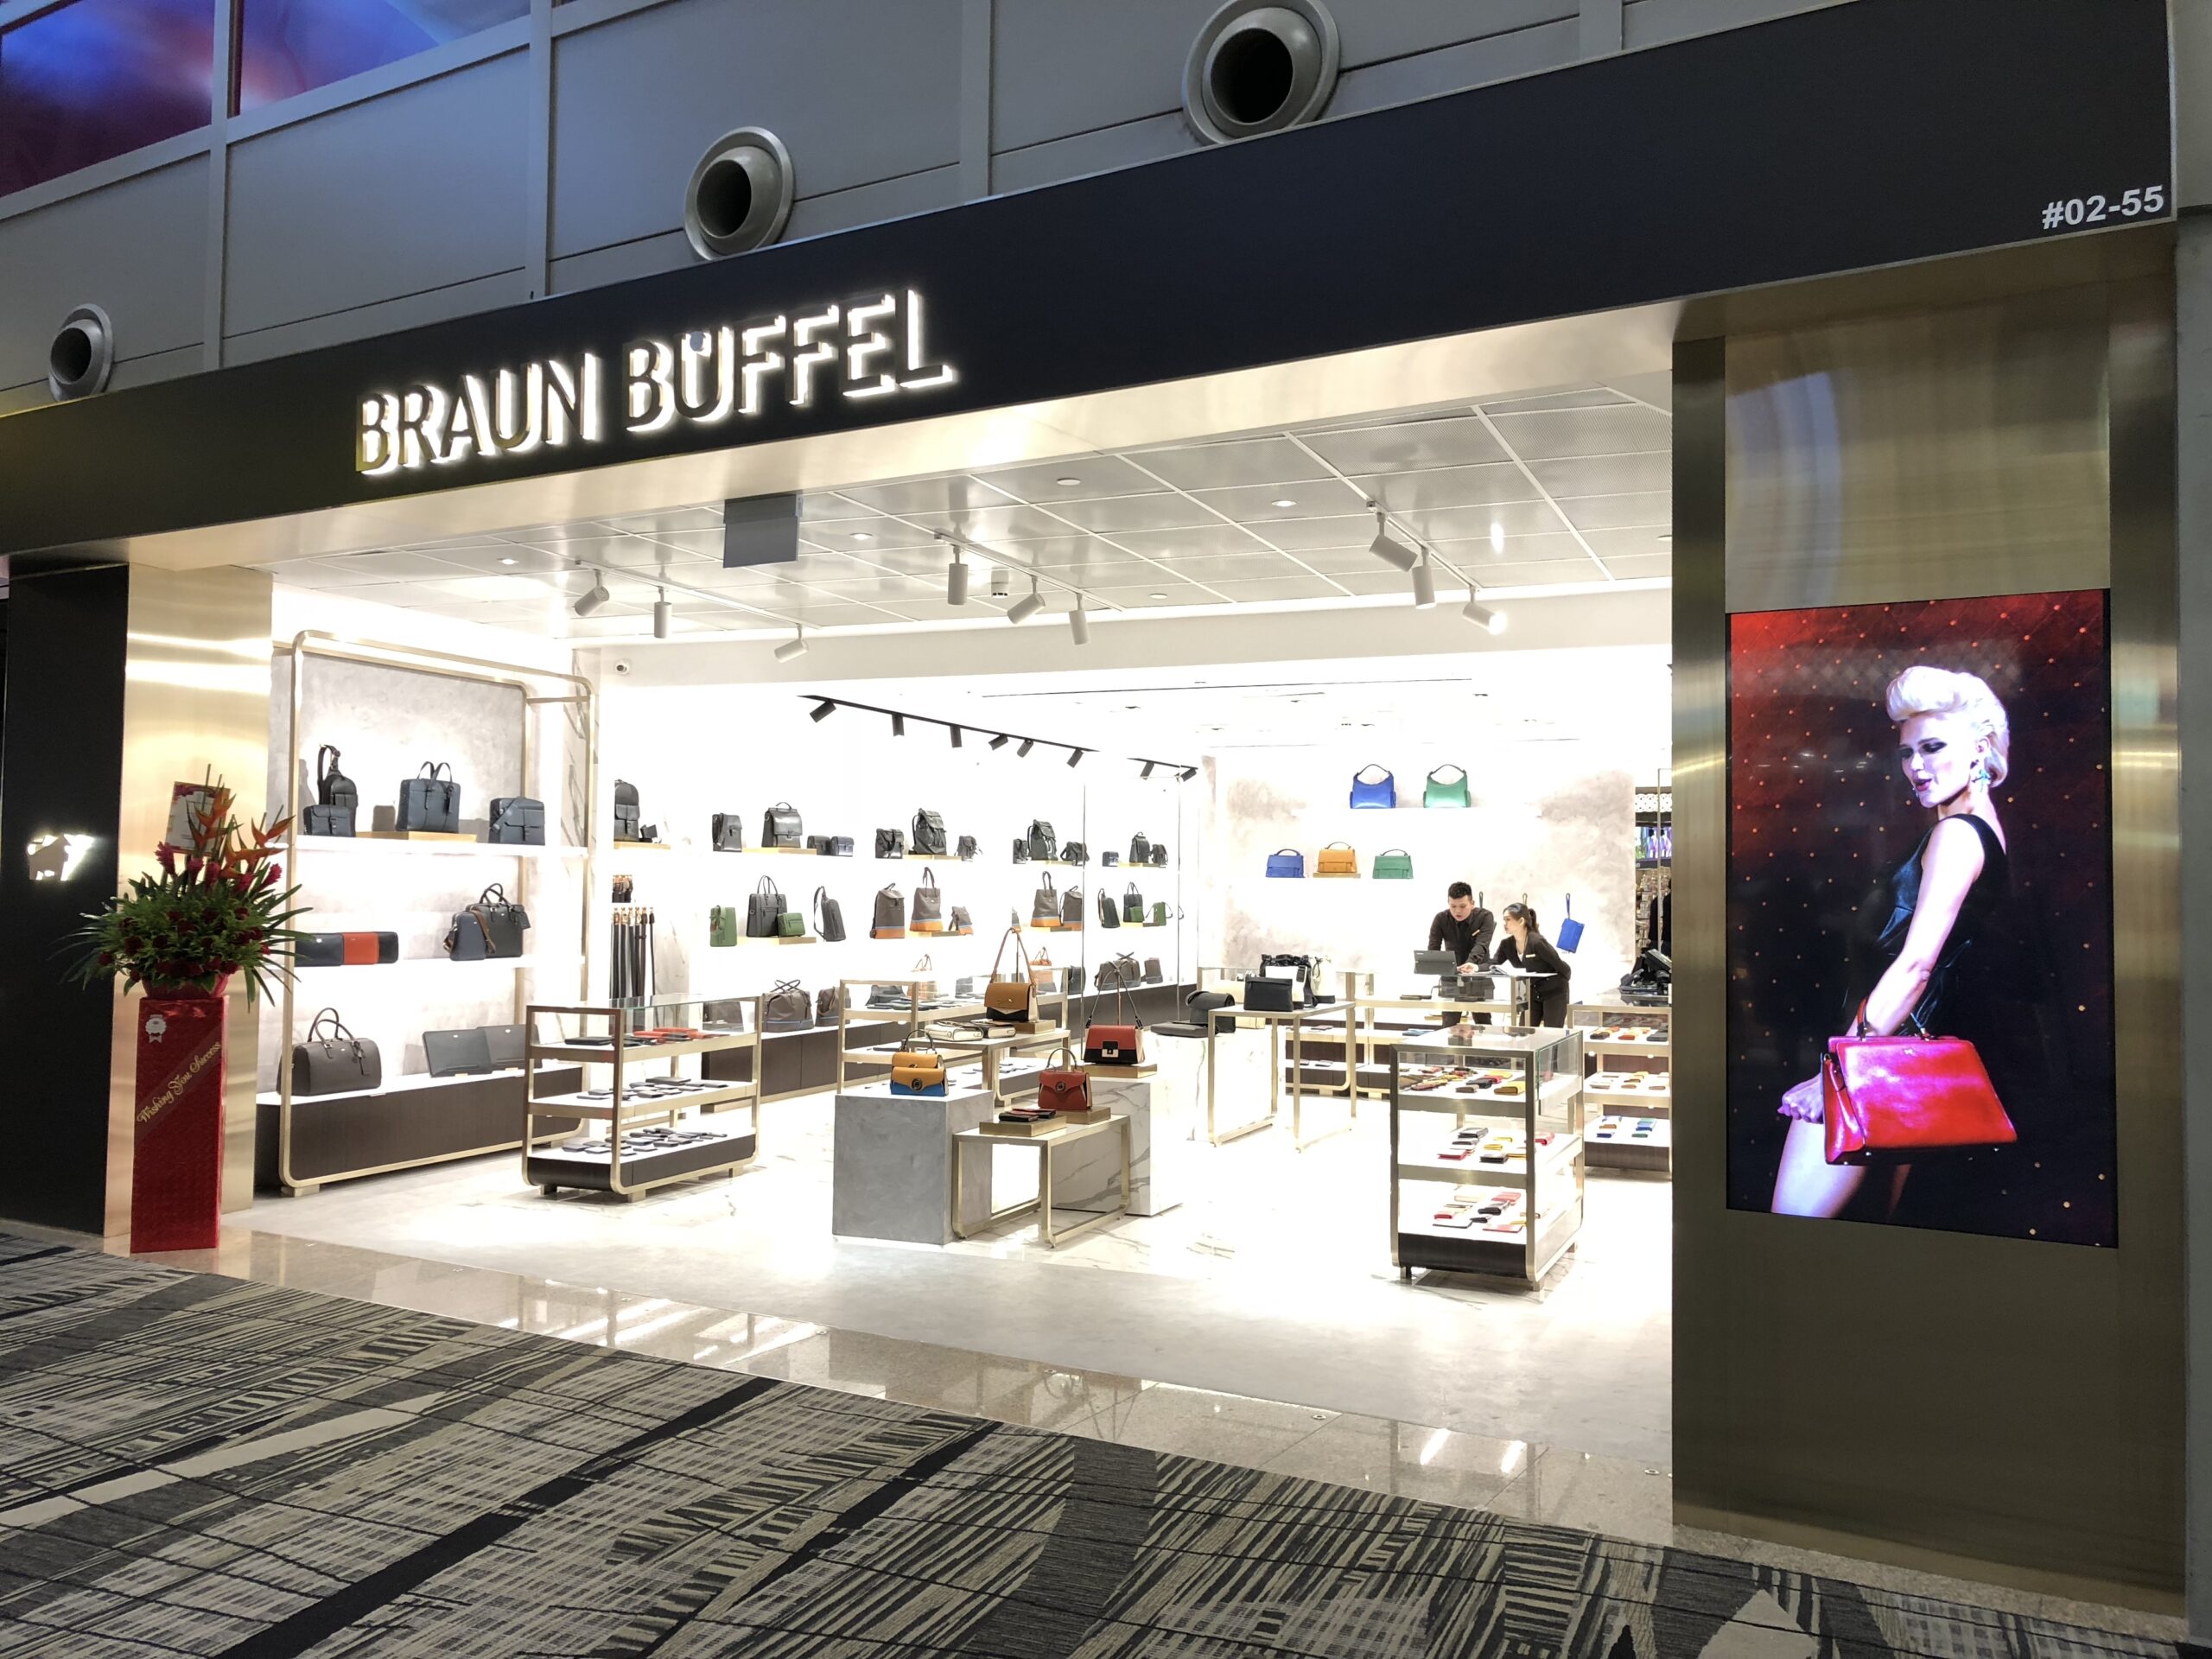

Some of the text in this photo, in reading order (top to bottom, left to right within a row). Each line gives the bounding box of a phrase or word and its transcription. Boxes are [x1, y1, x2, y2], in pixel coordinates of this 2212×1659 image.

[2042, 184, 2164, 230] #02-55
[355, 352, 601, 476] BRAUN
[137, 1041, 221, 1122] Wishing You Success
